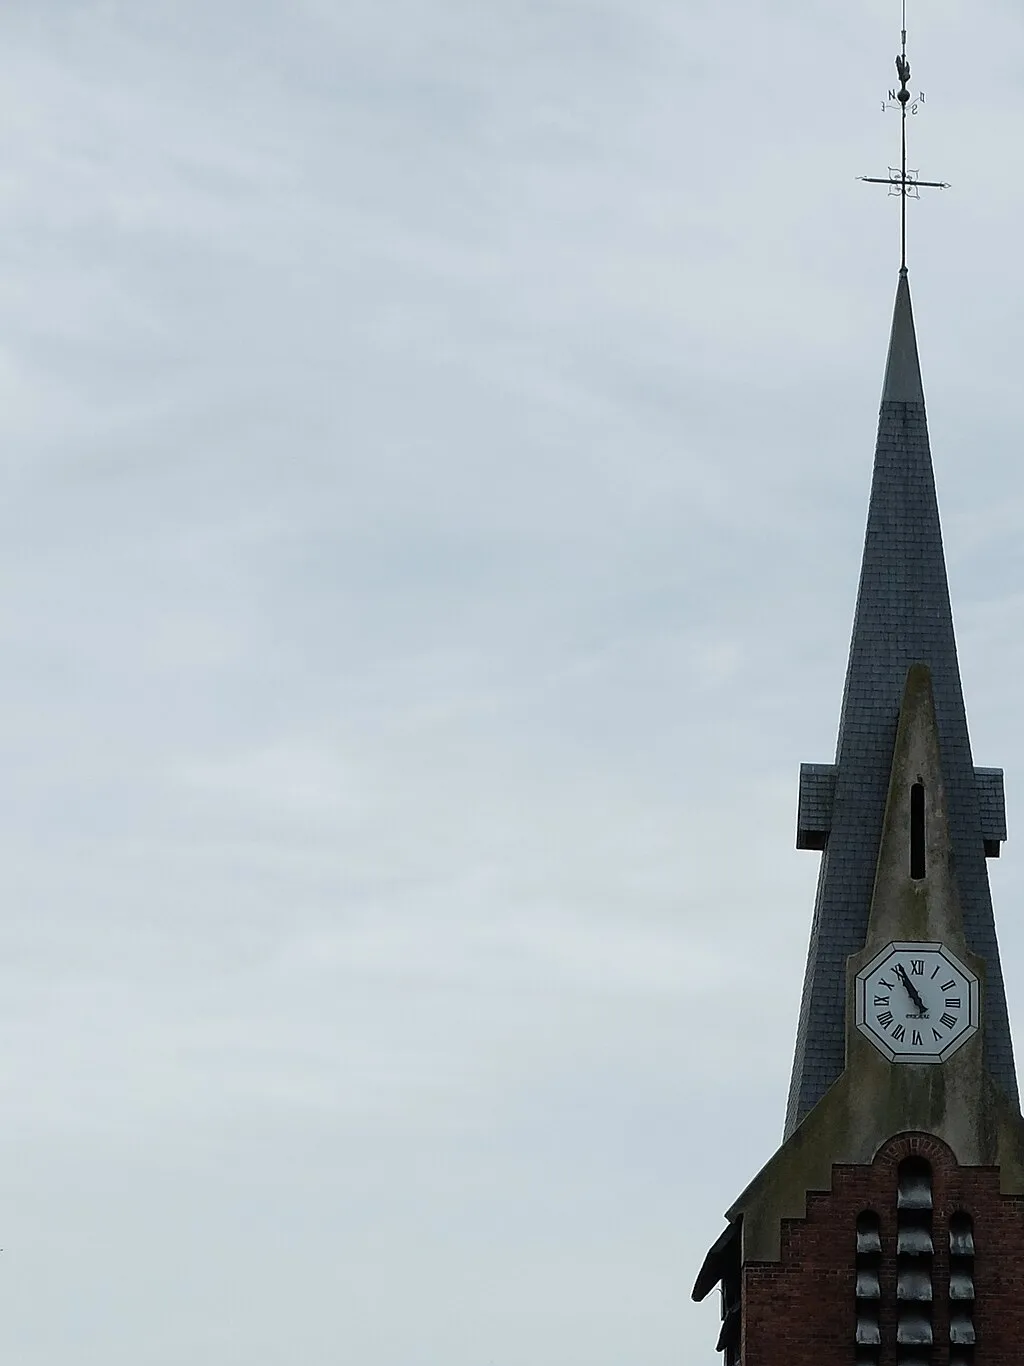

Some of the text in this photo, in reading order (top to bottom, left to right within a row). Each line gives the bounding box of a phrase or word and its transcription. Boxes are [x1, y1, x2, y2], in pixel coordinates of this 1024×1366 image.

[911, 960, 924, 975] XII
[931, 966, 940, 979] I
[878, 978, 894, 991] X
[940, 980, 956, 991] II
[874, 995, 889, 1006] IX
[945, 998, 961, 1008] III
[912, 1030, 923, 1046] VI
[931, 1027, 943, 1041] V
